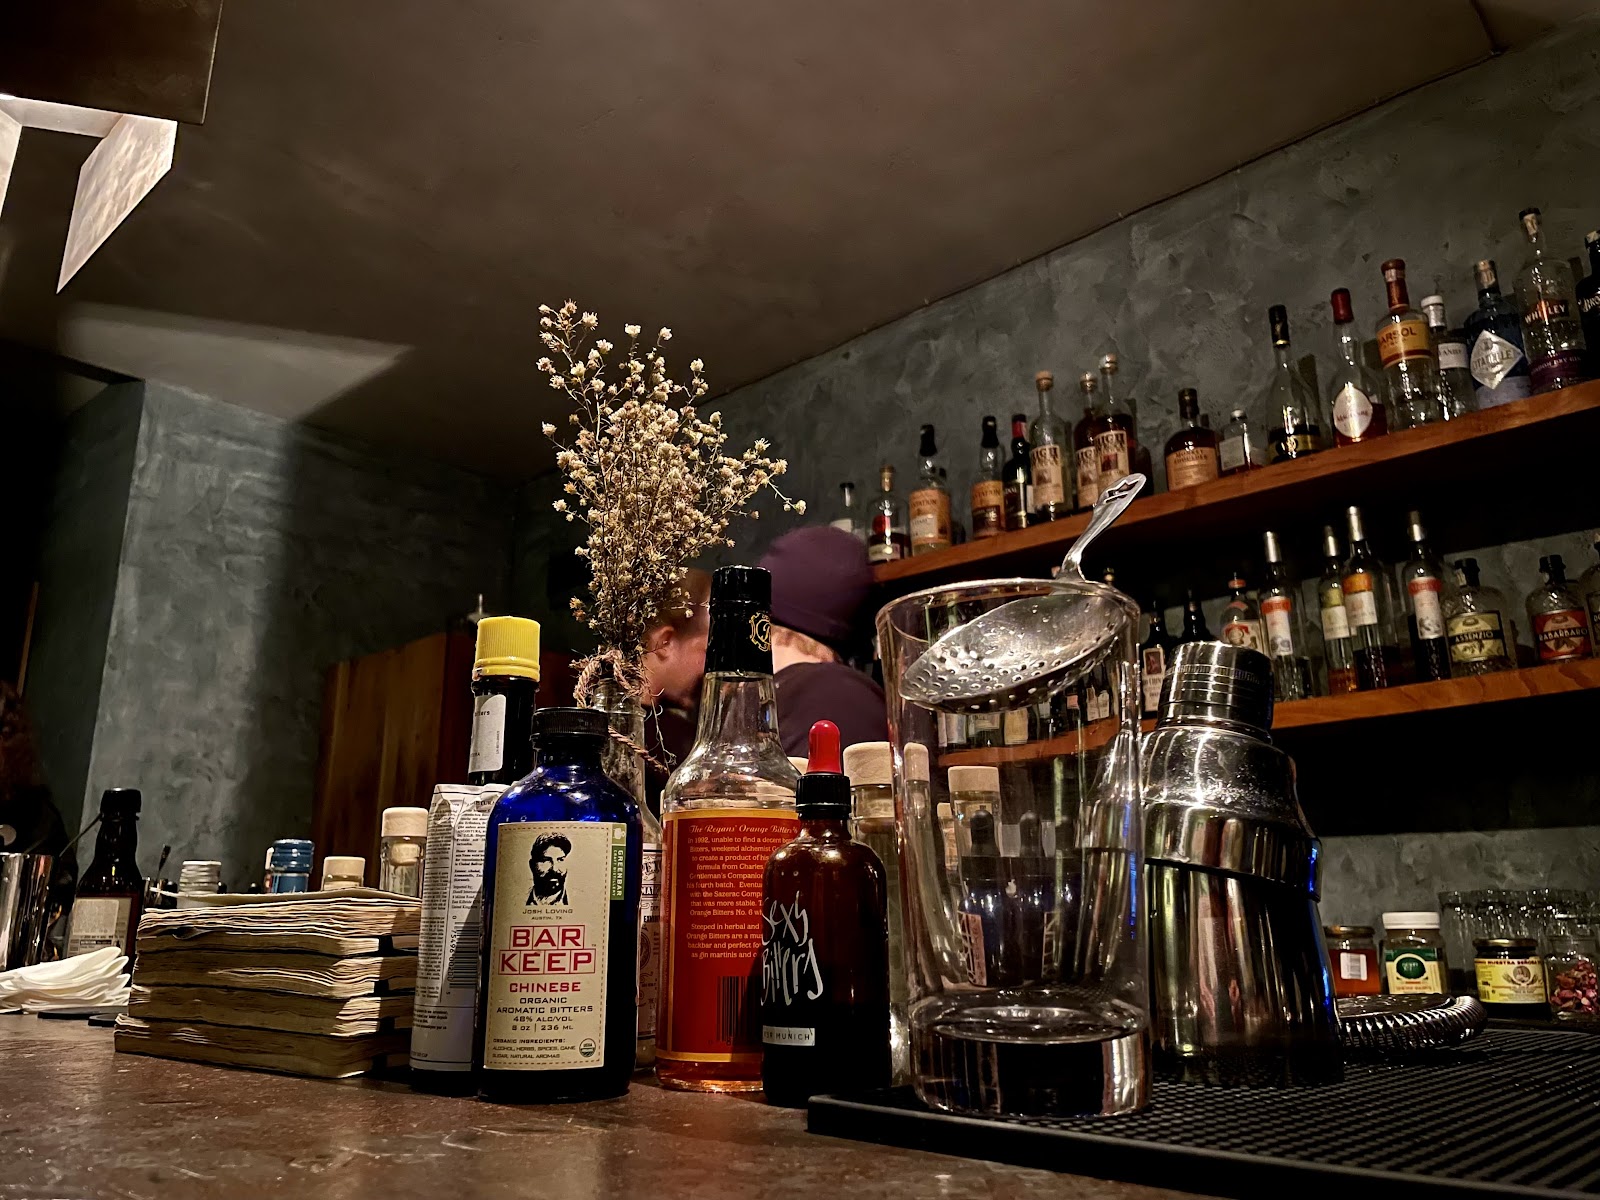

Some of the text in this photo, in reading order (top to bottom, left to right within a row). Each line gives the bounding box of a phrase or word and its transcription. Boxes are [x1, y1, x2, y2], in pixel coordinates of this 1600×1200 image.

[1382, 327, 1418, 344] ARSOL
[739, 824, 769, 834] Orange
[513, 929, 581, 947] BAR
[501, 952, 592, 972] KEEP
[509, 982, 581, 993] CHINESE
